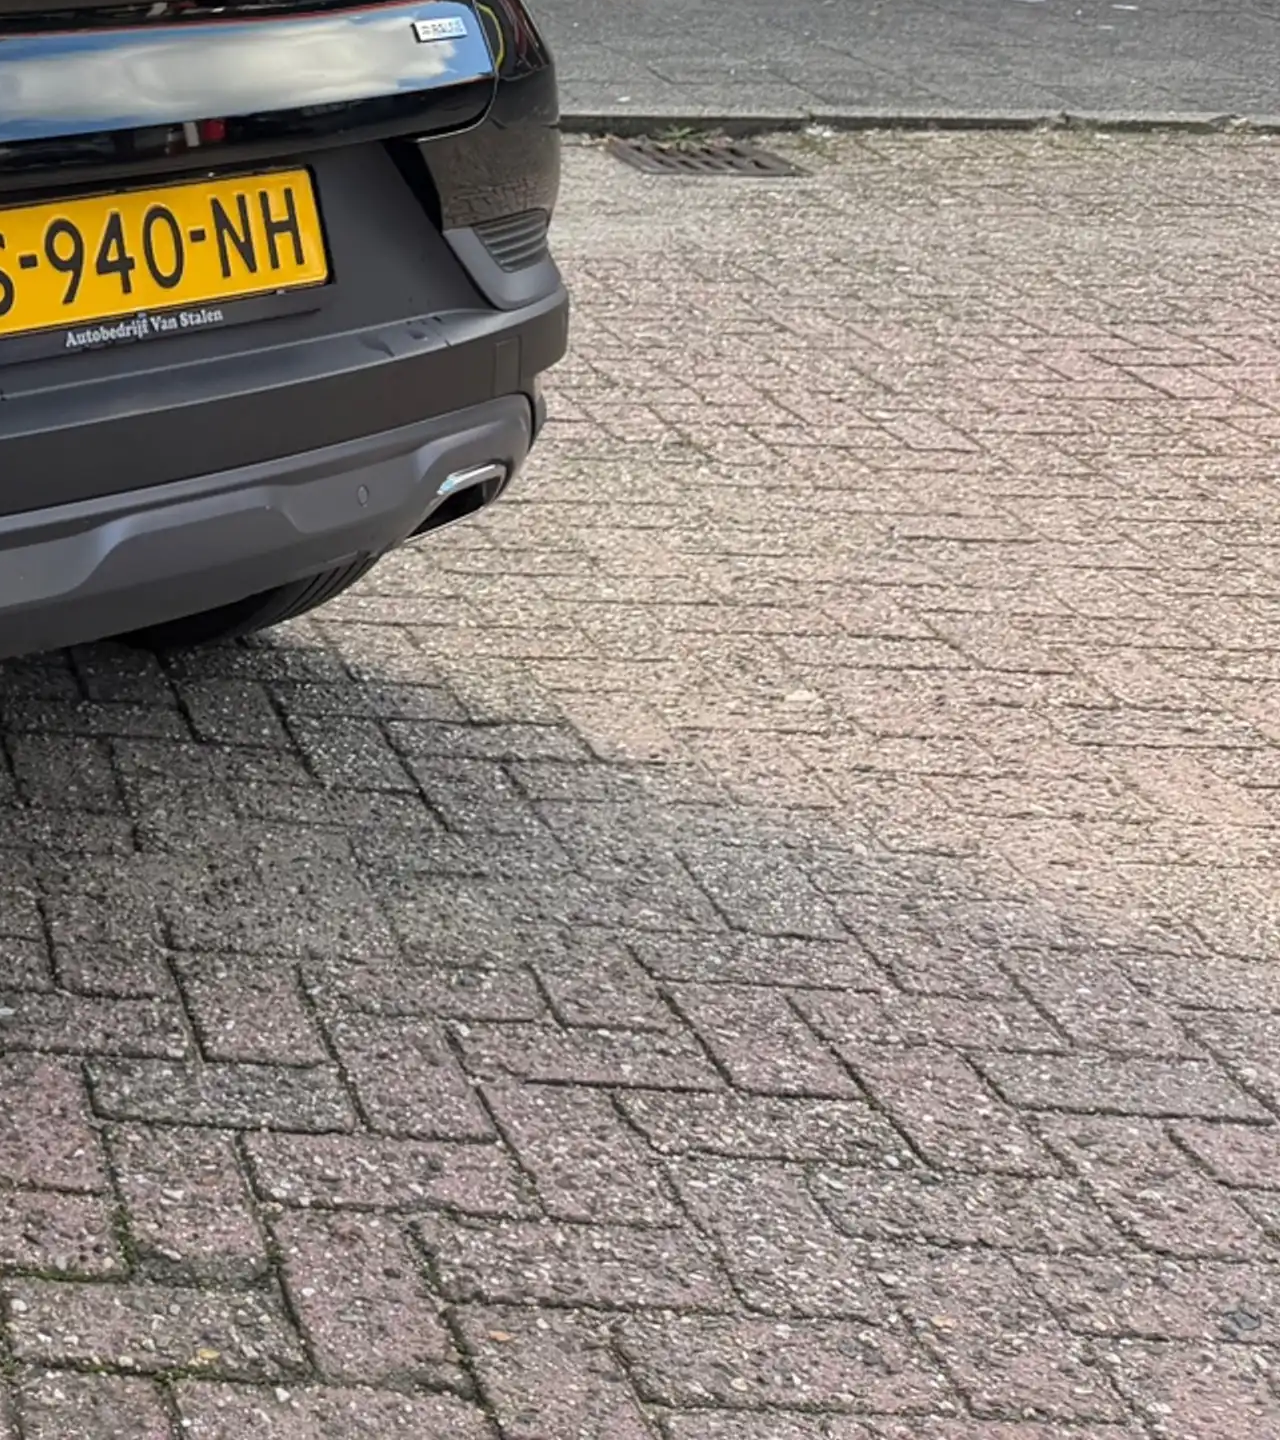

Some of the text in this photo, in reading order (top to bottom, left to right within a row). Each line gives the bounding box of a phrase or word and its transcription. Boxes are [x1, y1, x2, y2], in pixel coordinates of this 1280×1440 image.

[64, 307, 224, 348] Autobedrijf Van Stalen
